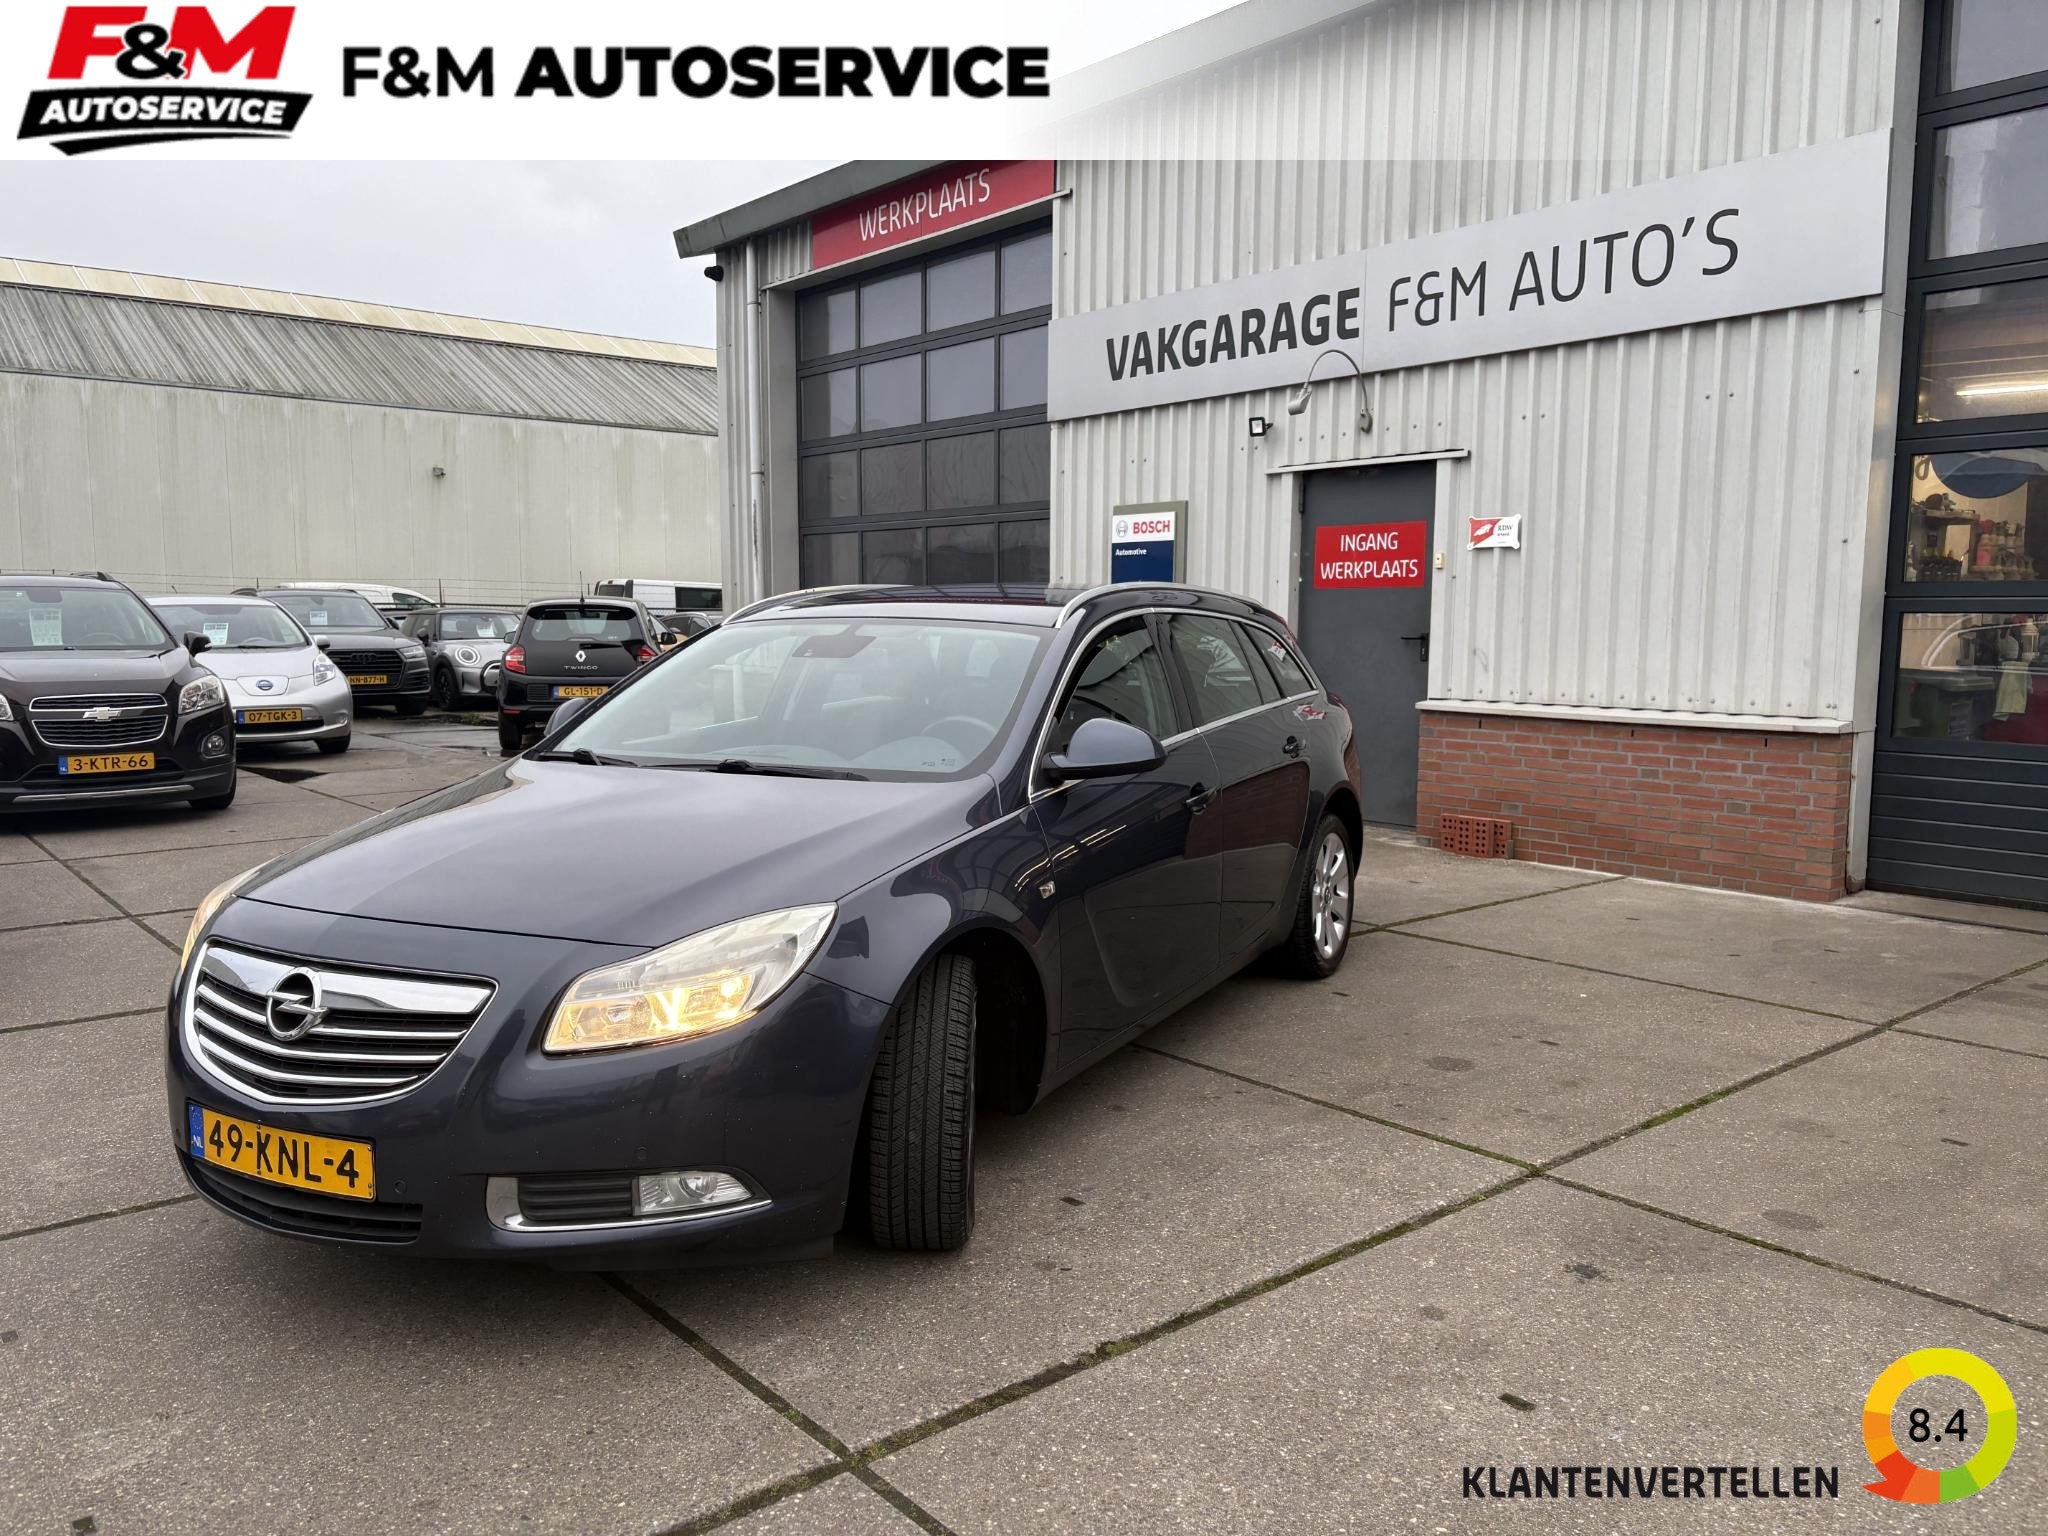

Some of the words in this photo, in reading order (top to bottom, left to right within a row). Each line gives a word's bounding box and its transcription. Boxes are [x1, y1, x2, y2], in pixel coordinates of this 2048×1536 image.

[859, 168, 991, 241] WERKPLAATS
[1106, 287, 1361, 381] VAKGARAGE
[1388, 260, 1488, 332] F&M
[1508, 208, 1740, 312] AUTO'S
[1133, 520, 1171, 534] BOSCH
[1340, 532, 1399, 552] INGANG
[1115, 548, 1147, 556] Automotive
[1320, 559, 1418, 580] WERKPLAATS
[564, 687, 603, 696] GL-151-D
[249, 712, 298, 722] 07-TGK-3
[73, 755, 148, 771] 3-KTR-66
[208, 1120, 359, 1189] 49-KNL-4
